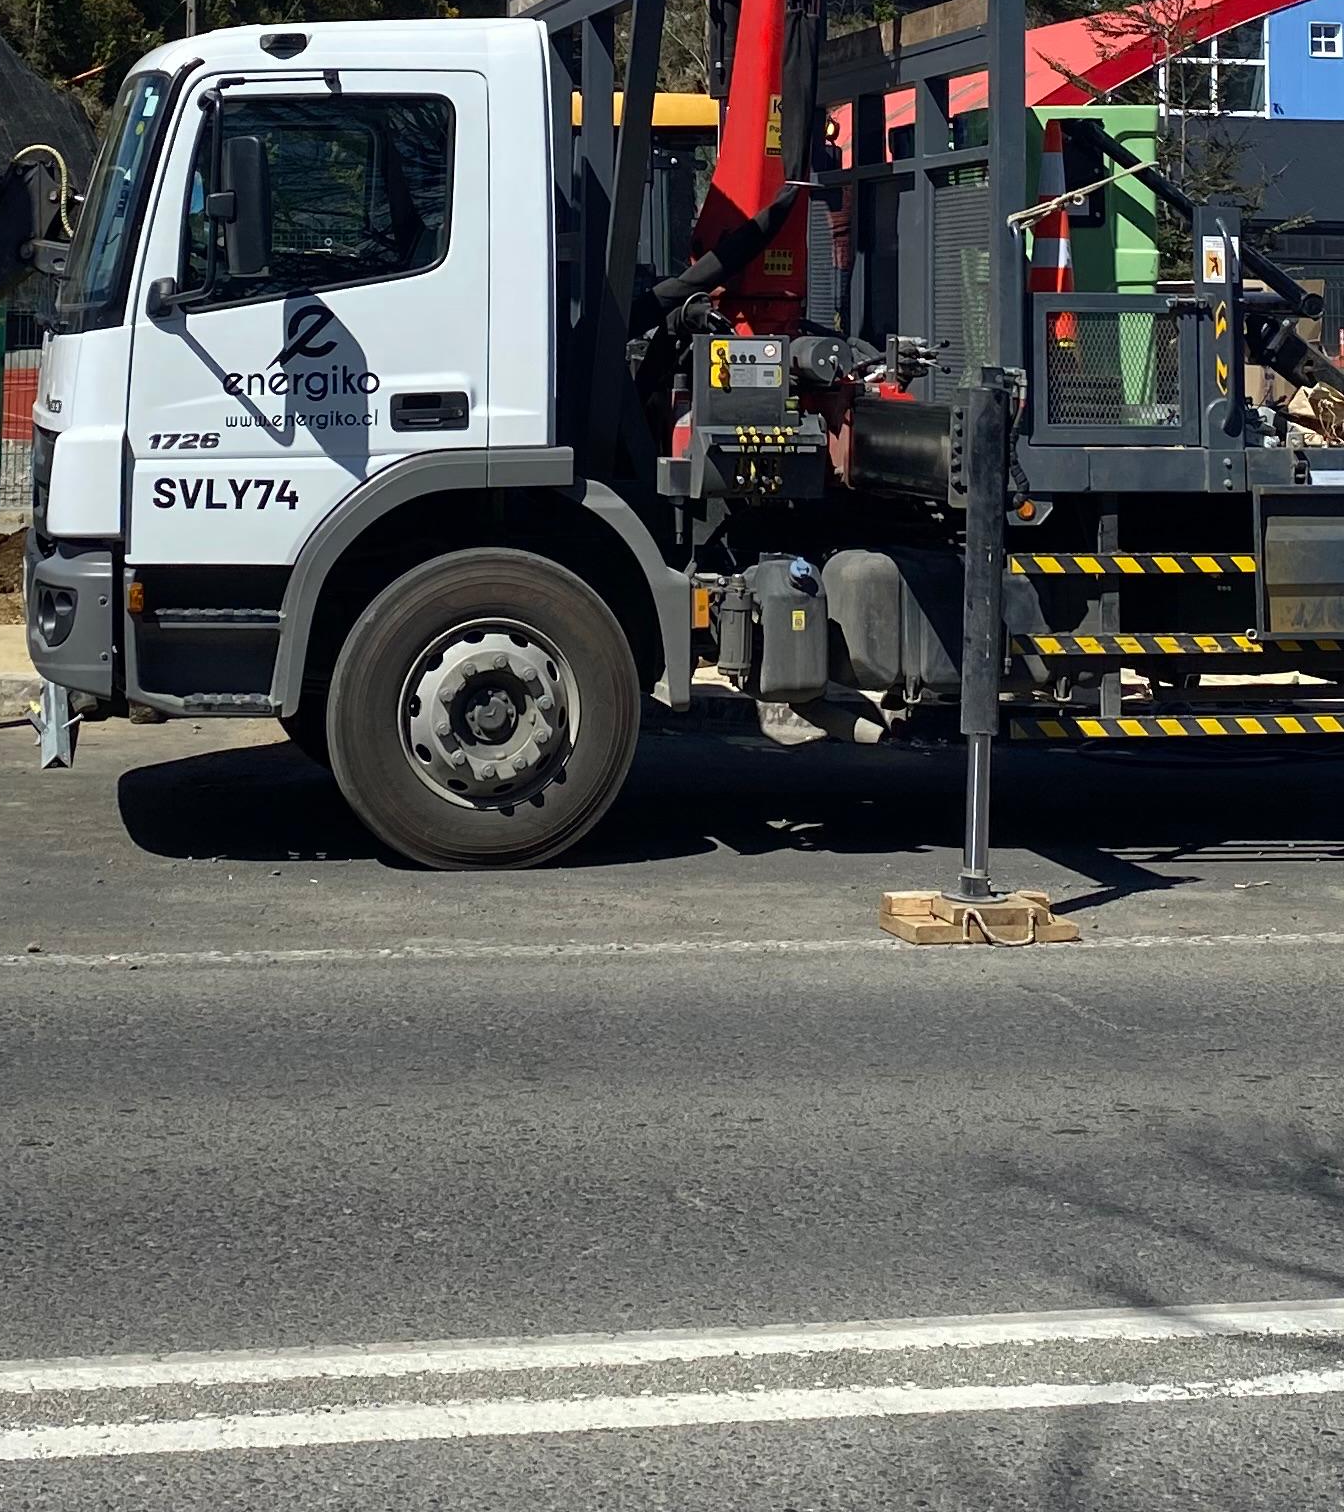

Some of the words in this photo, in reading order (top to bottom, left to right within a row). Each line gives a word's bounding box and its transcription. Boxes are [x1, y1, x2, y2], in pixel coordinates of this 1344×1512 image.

[223, 364, 381, 401] energiko
[224, 410, 379, 430] www.energiko.cl
[148, 433, 220, 450] 1726
[152, 477, 299, 511] SVLY74
